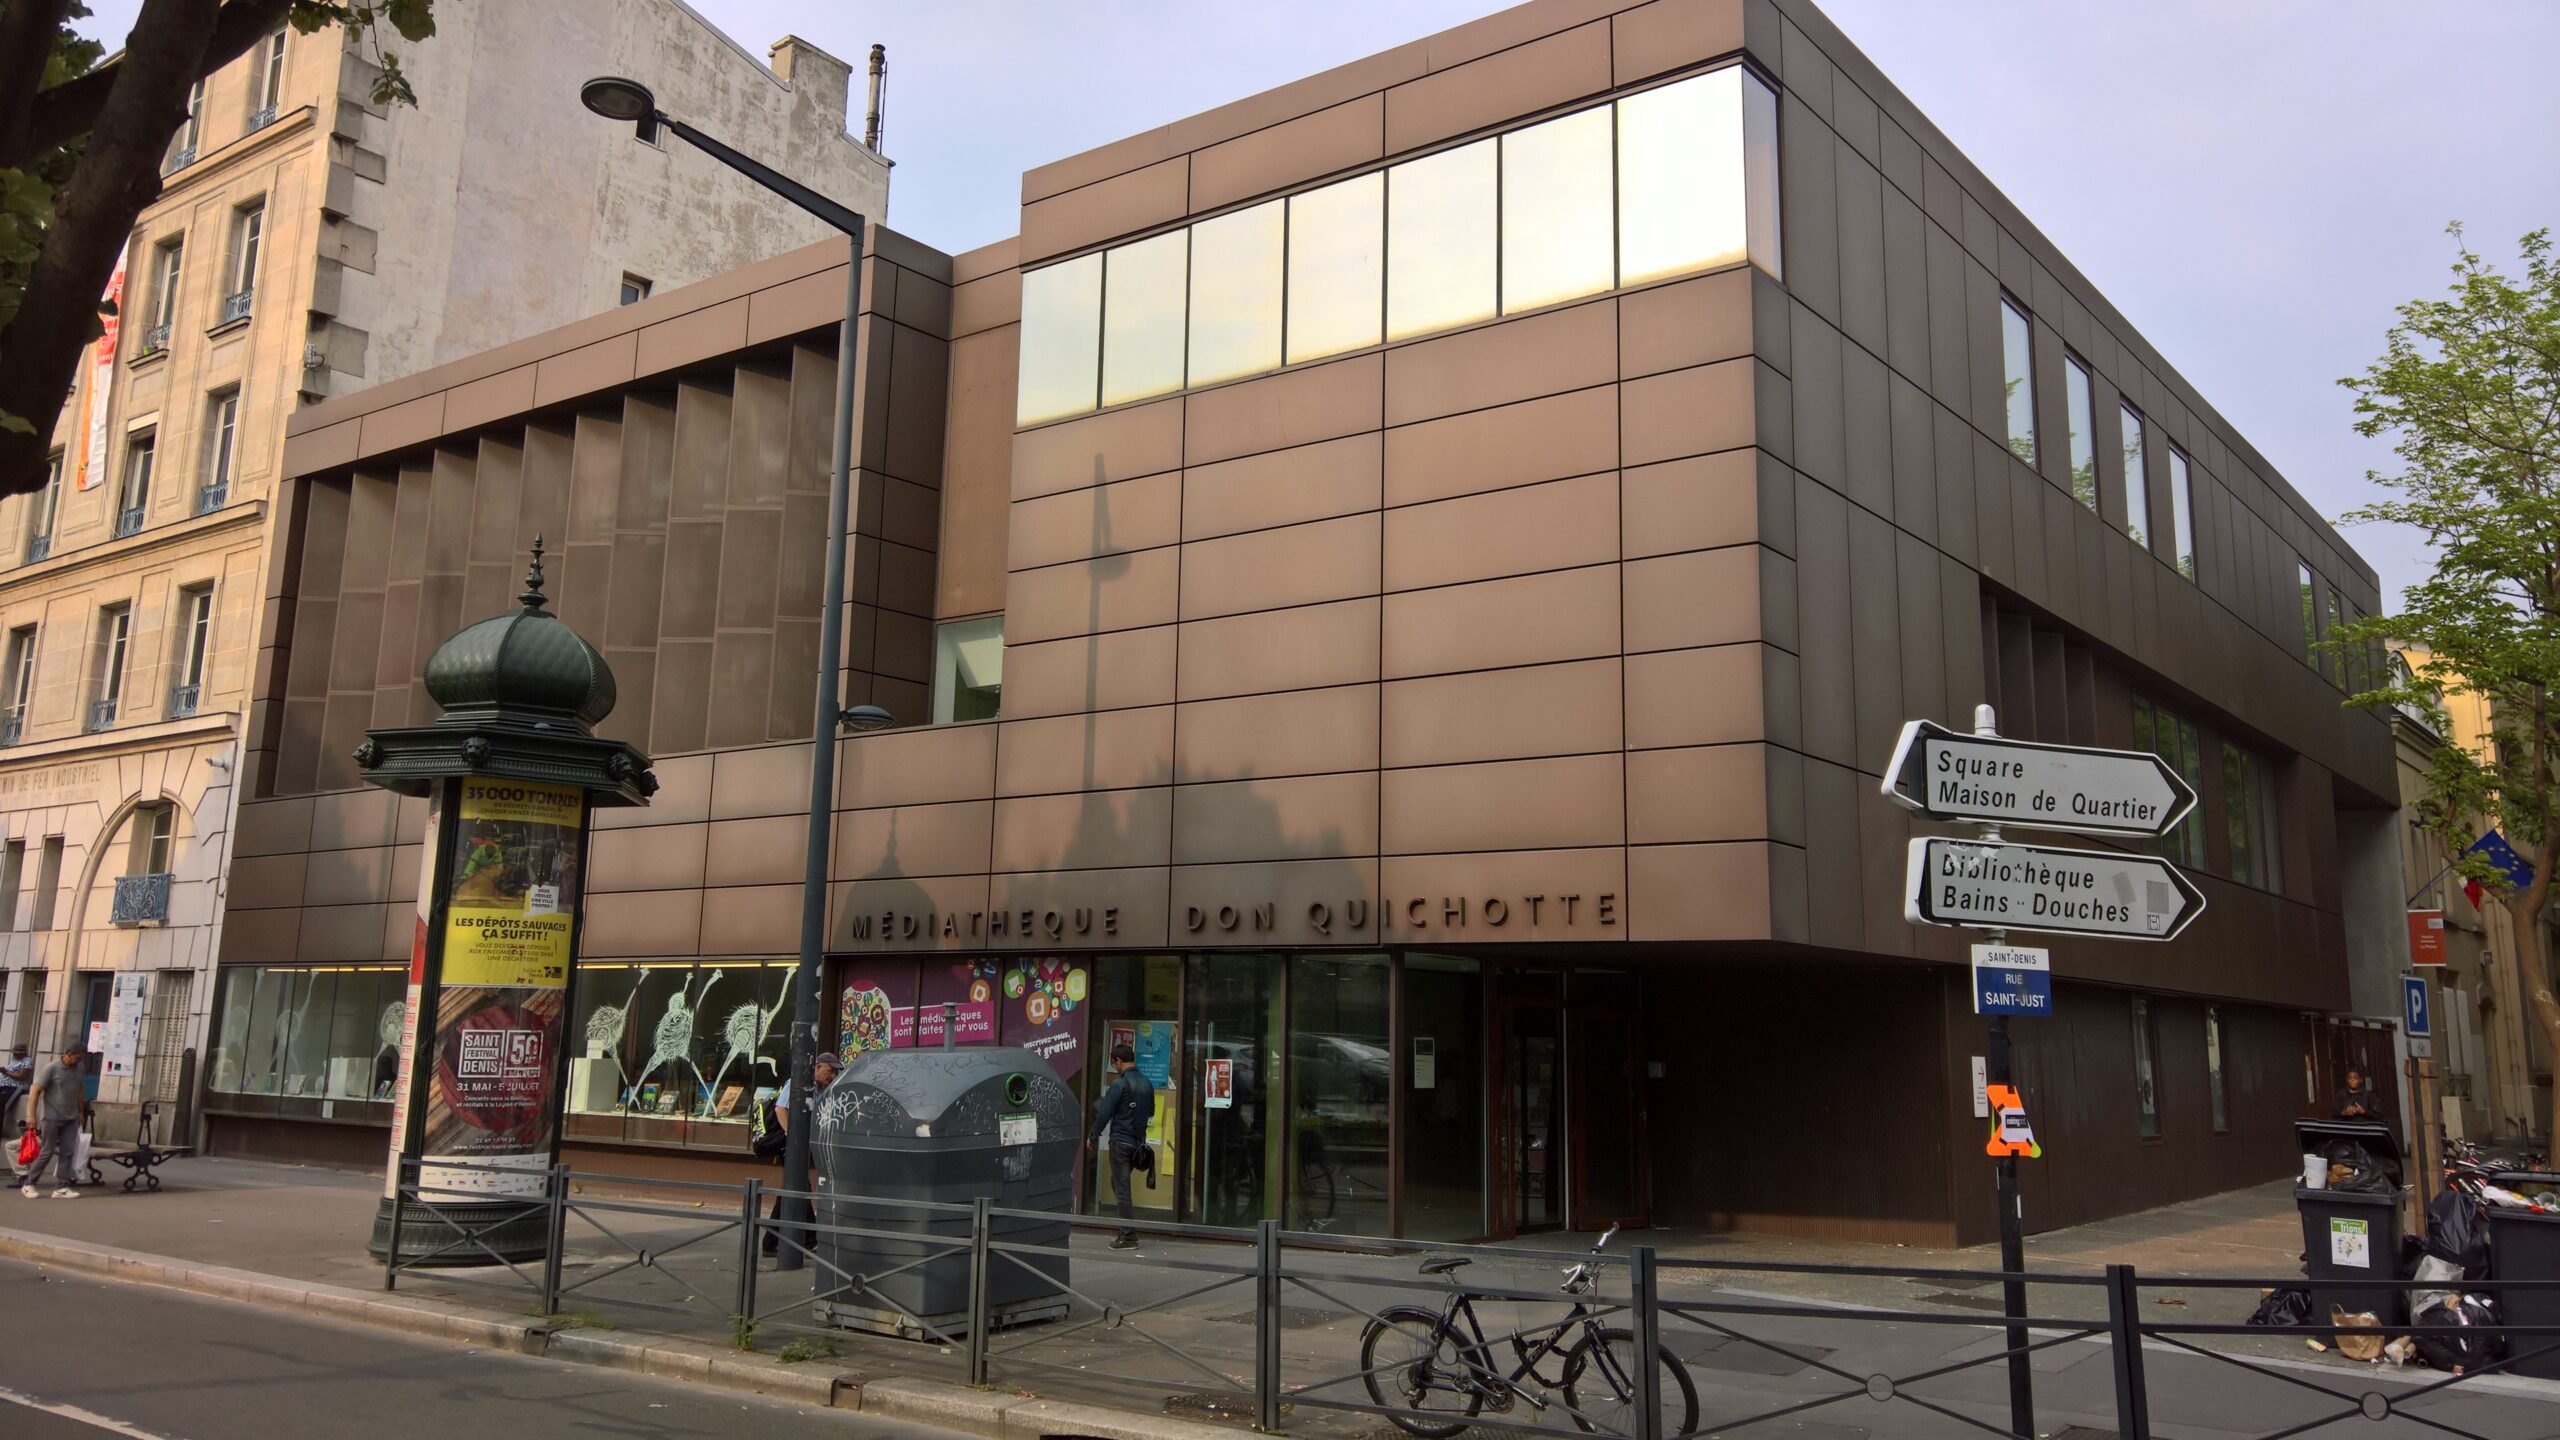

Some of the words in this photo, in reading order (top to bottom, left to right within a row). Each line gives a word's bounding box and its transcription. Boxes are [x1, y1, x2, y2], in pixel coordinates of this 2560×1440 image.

[1938, 750, 2023, 780] Square
[33, 771, 49, 791] FER
[52, 765, 99, 787] INDUSTRIEL
[1939, 781, 2016, 809] Maison
[2032, 789, 2056, 812] de
[2072, 792, 2157, 820] Quartier
[1942, 854, 2094, 892] Bibliohèque
[1943, 886, 2008, 913] Bains
[2033, 893, 2129, 922] Douches
[1186, 901, 1275, 932] DON
[1307, 893, 1616, 936] QUICHOTTE
[456, 918, 474, 926] LES
[476, 916, 520, 928] DÉPÔTS
[522, 920, 567, 931] SAUVAGES
[482, 929, 498, 941] ÇA
[1988, 952, 2036, 964] SAINT-DENIS
[2005, 974, 2023, 984] RUE
[1985, 992, 2045, 1007] SAINT-JUST
[2411, 988, 2422, 1023] P
[900, 1016, 914, 1025] Les
[894, 1027, 912, 1037] sont
[919, 1024, 944, 1036] faites
[968, 1022, 988, 1031] vous
[465, 1034, 500, 1047] SAINT
[466, 1049, 497, 1058] FESTIVAL
[1043, 1038, 1076, 1059] gratuit
[463, 1060, 498, 1073] DENIS
[456, 1083, 469, 1091] 31
[472, 1083, 491, 1091] MAI
[506, 1082, 540, 1091] JUILLET
